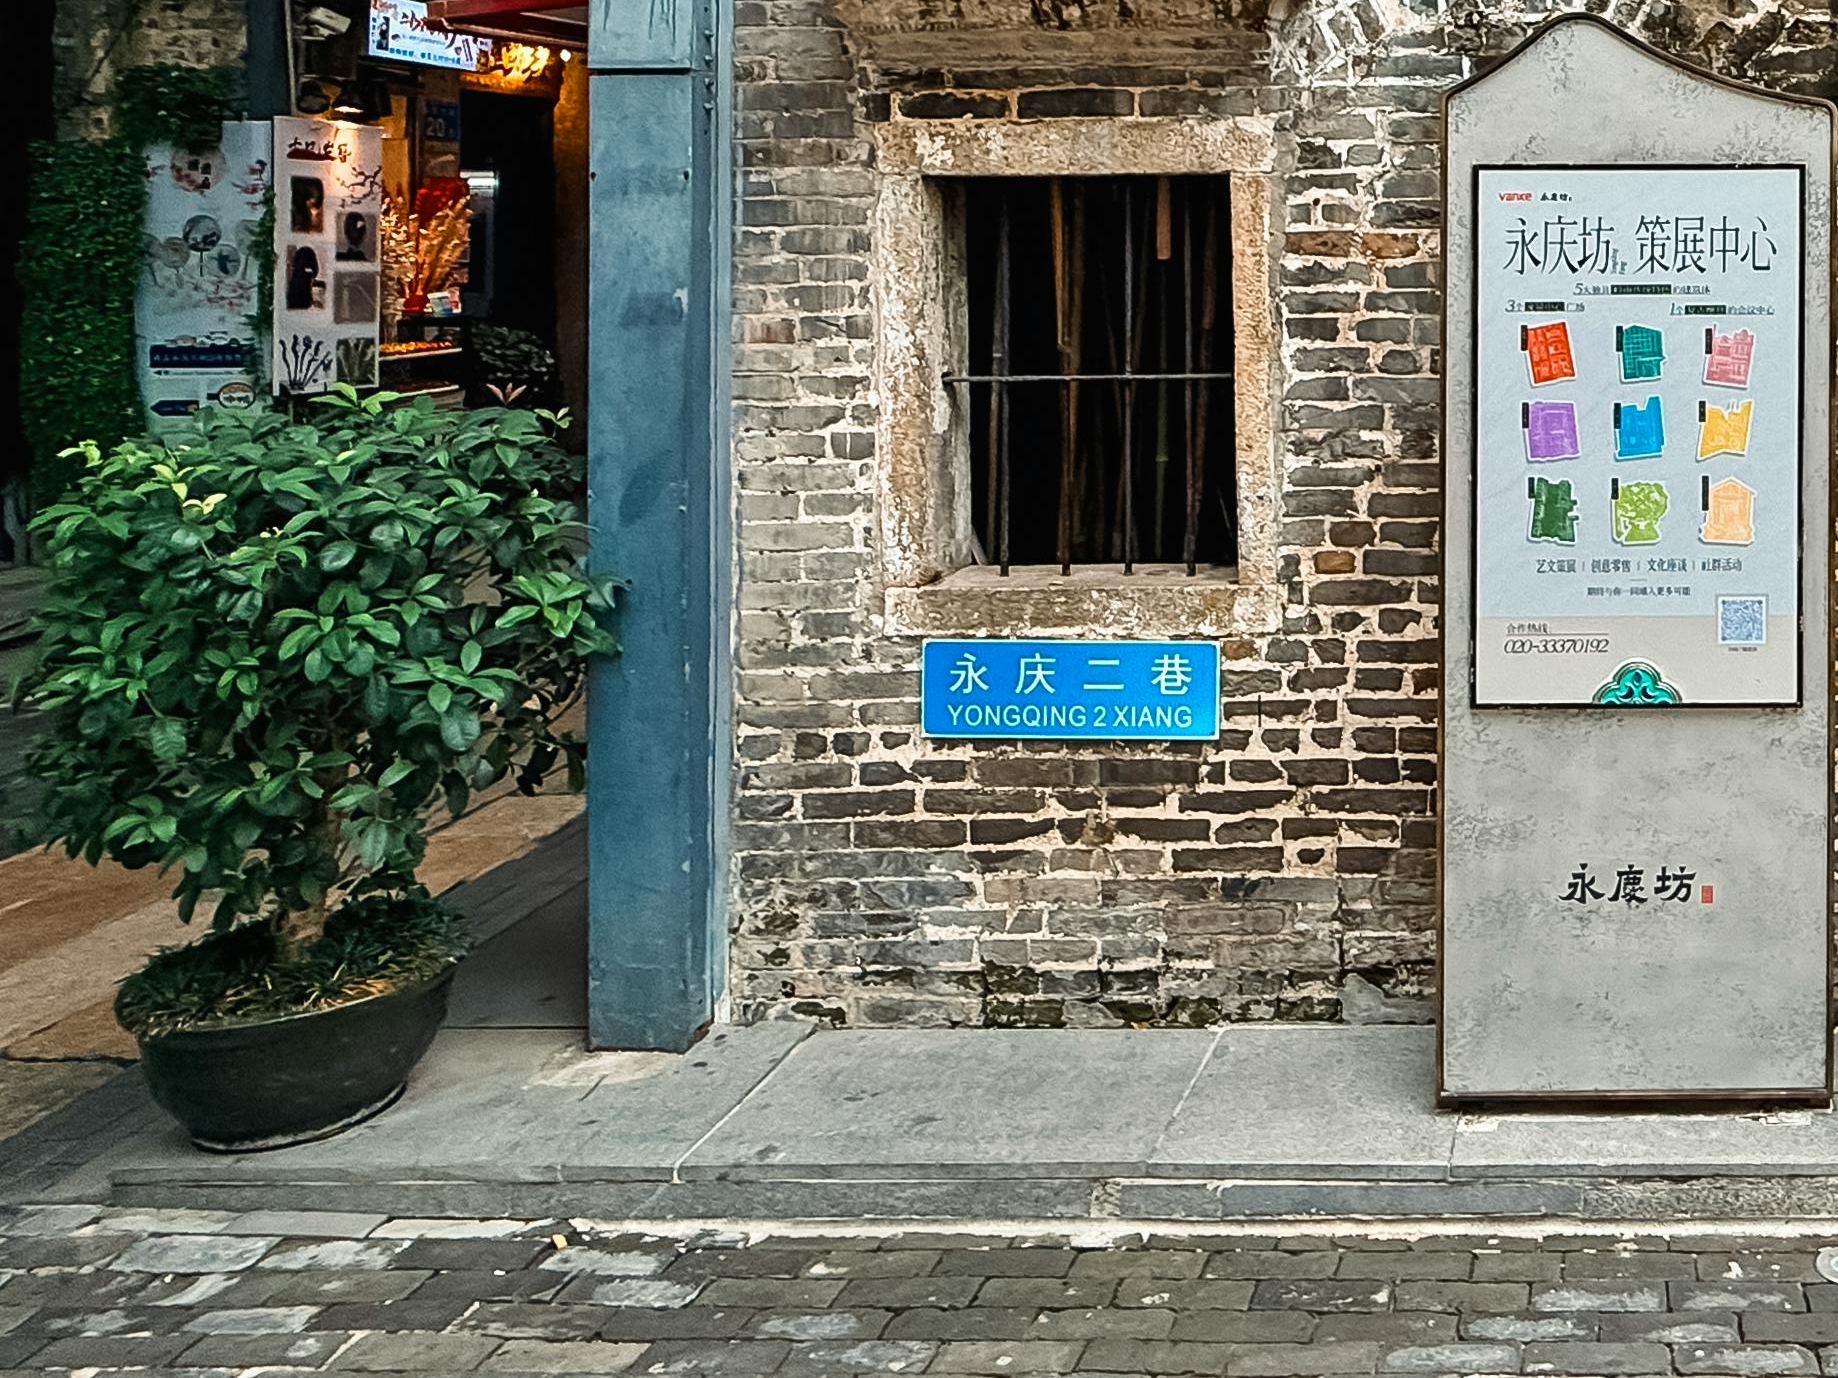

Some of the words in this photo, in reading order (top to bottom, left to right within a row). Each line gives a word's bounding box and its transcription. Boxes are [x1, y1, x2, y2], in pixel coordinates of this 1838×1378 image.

[1503, 215, 1614, 275] 永庆坊
[1633, 215, 1777, 275] 策展中心
[1503, 638, 1610, 654] 020-33370192
[949, 652, 1192, 695] 永庆二巷
[947, 705, 1086, 728] YONGQING
[1093, 705, 1107, 727] 2
[1112, 705, 1192, 728] XIANG
